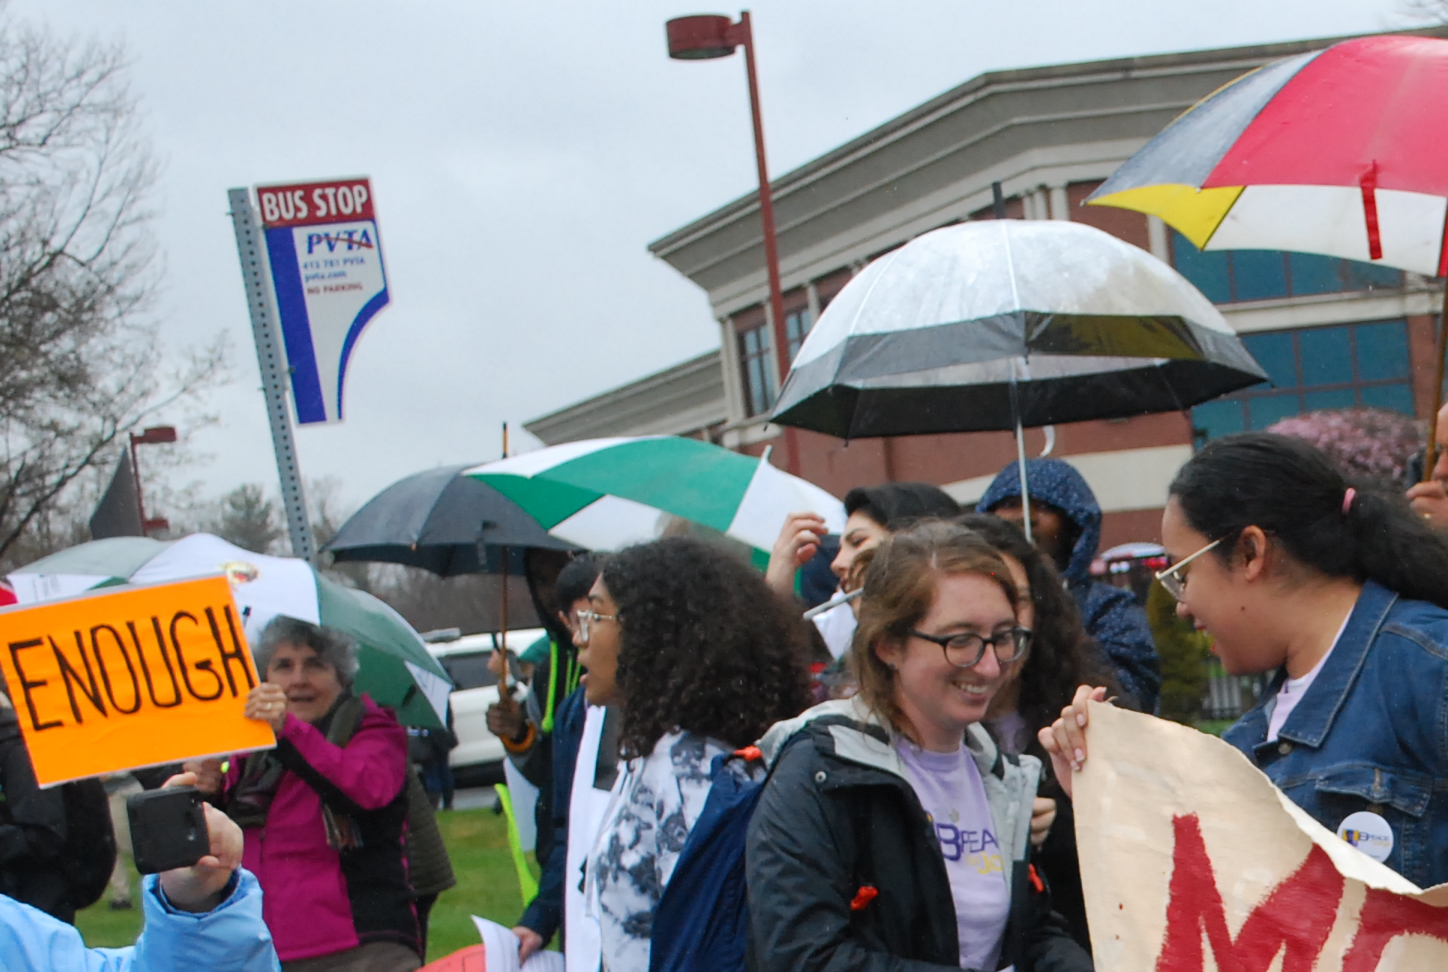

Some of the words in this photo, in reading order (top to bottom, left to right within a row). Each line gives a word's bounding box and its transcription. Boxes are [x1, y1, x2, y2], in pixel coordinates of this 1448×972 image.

[262, 189, 309, 222] BUS
[312, 184, 369, 217] STOP
[307, 228, 374, 255] PVTA
[8, 604, 257, 732] ENOUGH
